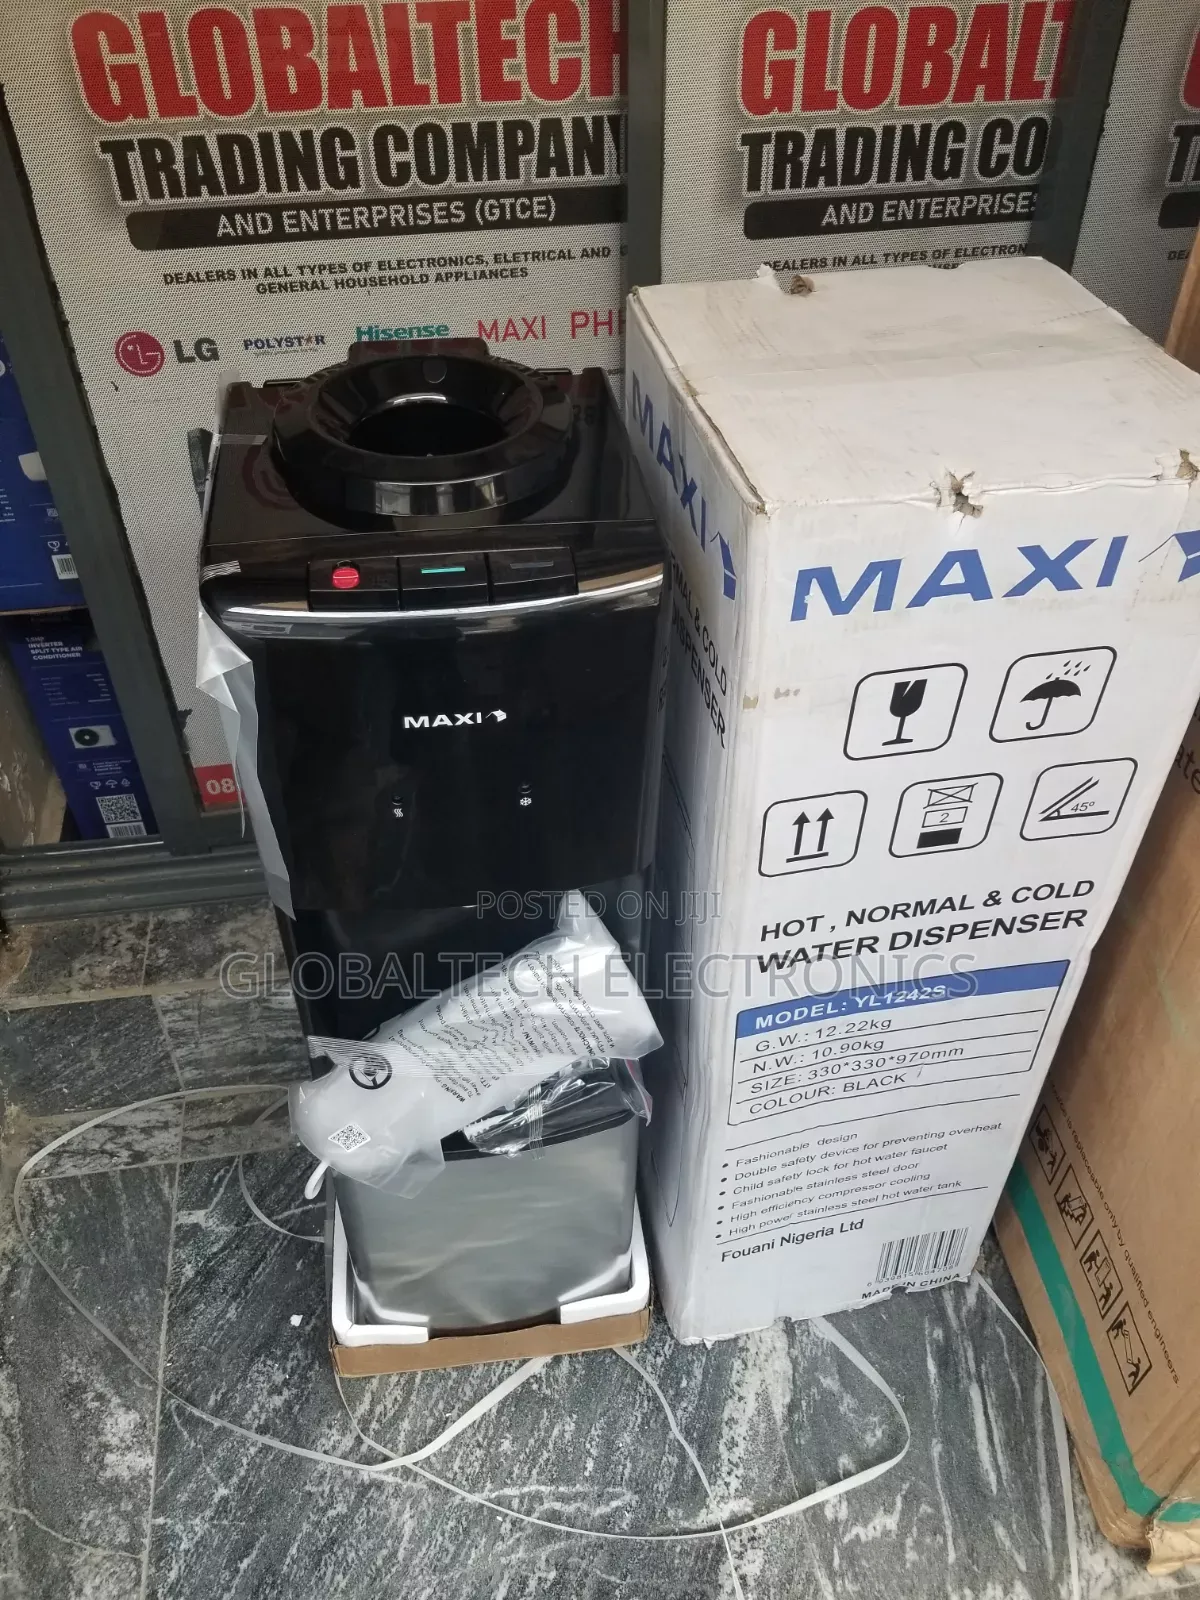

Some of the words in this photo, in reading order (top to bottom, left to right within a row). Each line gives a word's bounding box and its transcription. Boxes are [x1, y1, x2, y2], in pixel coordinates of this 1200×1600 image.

[100, 126, 360, 202] TRADING
[740, 119, 966, 191] TRADING
[216, 212, 273, 238] AND
[283, 202, 466, 234] ENTERPRISES
[475, 195, 557, 224] (GTCE)
[821, 204, 874, 227] AND
[163, 268, 236, 286] DEALERS
[241, 268, 258, 281] IN
[263, 266, 292, 279] ALL
[298, 262, 348, 277] TYPES
[352, 261, 372, 274] OF
[377, 254, 489, 271] ELECTRONICS,
[493, 249, 576, 264] ELETRICAL
[580, 246, 611, 259] AND
[256, 279, 330, 295] GENERAL
[334, 274, 429, 289] HOUSEHOLD
[434, 267, 528, 283] APPLIANCES
[833, 256, 848, 268] IN
[852, 253, 878, 266] ALL
[883, 250, 927, 264] TYPES
[932, 249, 950, 260] OF
[173, 337, 219, 363] LG
[355, 324, 449, 341] Hisense
[477, 315, 547, 343] MAXI
[632, 370, 707, 553] MAXI
[790, 535, 1129, 622] MAXI
[33, 652, 82, 660] CONDITIONER
[702, 625, 727, 697] COLD
[403, 711, 483, 730] MAXI
[845, 894, 975, 927] NORMAL
[983, 890, 1002, 907] &
[1011, 879, 1095, 904] COLD
[757, 937, 879, 974] WATER
[888, 909, 1089, 951] DISPENSER
[755, 999, 847, 1030] MODEL:
[854, 984, 946, 1009] YL1242S
[815, 1017, 893, 1040] 12.22kg
[811, 1038, 885, 1061] 10.90kg
[749, 1083, 837, 1115] COLOUR:
[843, 1071, 907, 1093] BLACK
[751, 1073, 803, 1095] SIZE:
[733, 1180, 764, 1195] Child
[767, 1170, 803, 1187] safety
[806, 1165, 830, 1177] lock
[833, 1161, 850, 1172] for
[852, 1157, 871, 1167] hot
[875, 1150, 908, 1162] water
[911, 1143, 948, 1155] faucet
[734, 1164, 777, 1181] Double
[781, 1154, 817, 1170] safety
[820, 1146, 860, 1159] device
[863, 1141, 879, 1151] for
[882, 1130, 945, 1149] preventing
[949, 1122, 1002, 1136] overheat
[736, 1141, 809, 1168] Fashionable
[817, 1132, 858, 1147] design
[729, 1223, 756, 1237] High
[759, 1213, 794, 1231] power
[797, 1202, 848, 1218] stainless
[850, 1195, 879, 1207] steel
[882, 1191, 900, 1201] hot
[903, 1185, 934, 1196] water
[937, 1180, 962, 1190] tank
[730, 1209, 757, 1223] High
[760, 1195, 815, 1217] efficiency
[818, 1181, 887, 1202] compressor
[890, 1173, 931, 1187] cooling
[731, 1184, 803, 1210] Fashionable
[806, 1173, 858, 1190] stainless
[861, 1165, 889, 1177] steel
[893, 1161, 920, 1172] door
[721, 1240, 775, 1262] Fouani
[779, 1225, 835, 1248] Nigeria
[839, 1219, 864, 1233] Ltd
[1066, 1118, 1074, 1131] is
[1071, 1129, 1105, 1201] replaceable
[1104, 1201, 1119, 1224] only
[1117, 1227, 1127, 1247] by
[1123, 1249, 1150, 1308] qualified
[1148, 1310, 1180, 1388] engineers.
[919, 1273, 960, 1287] CHINA
